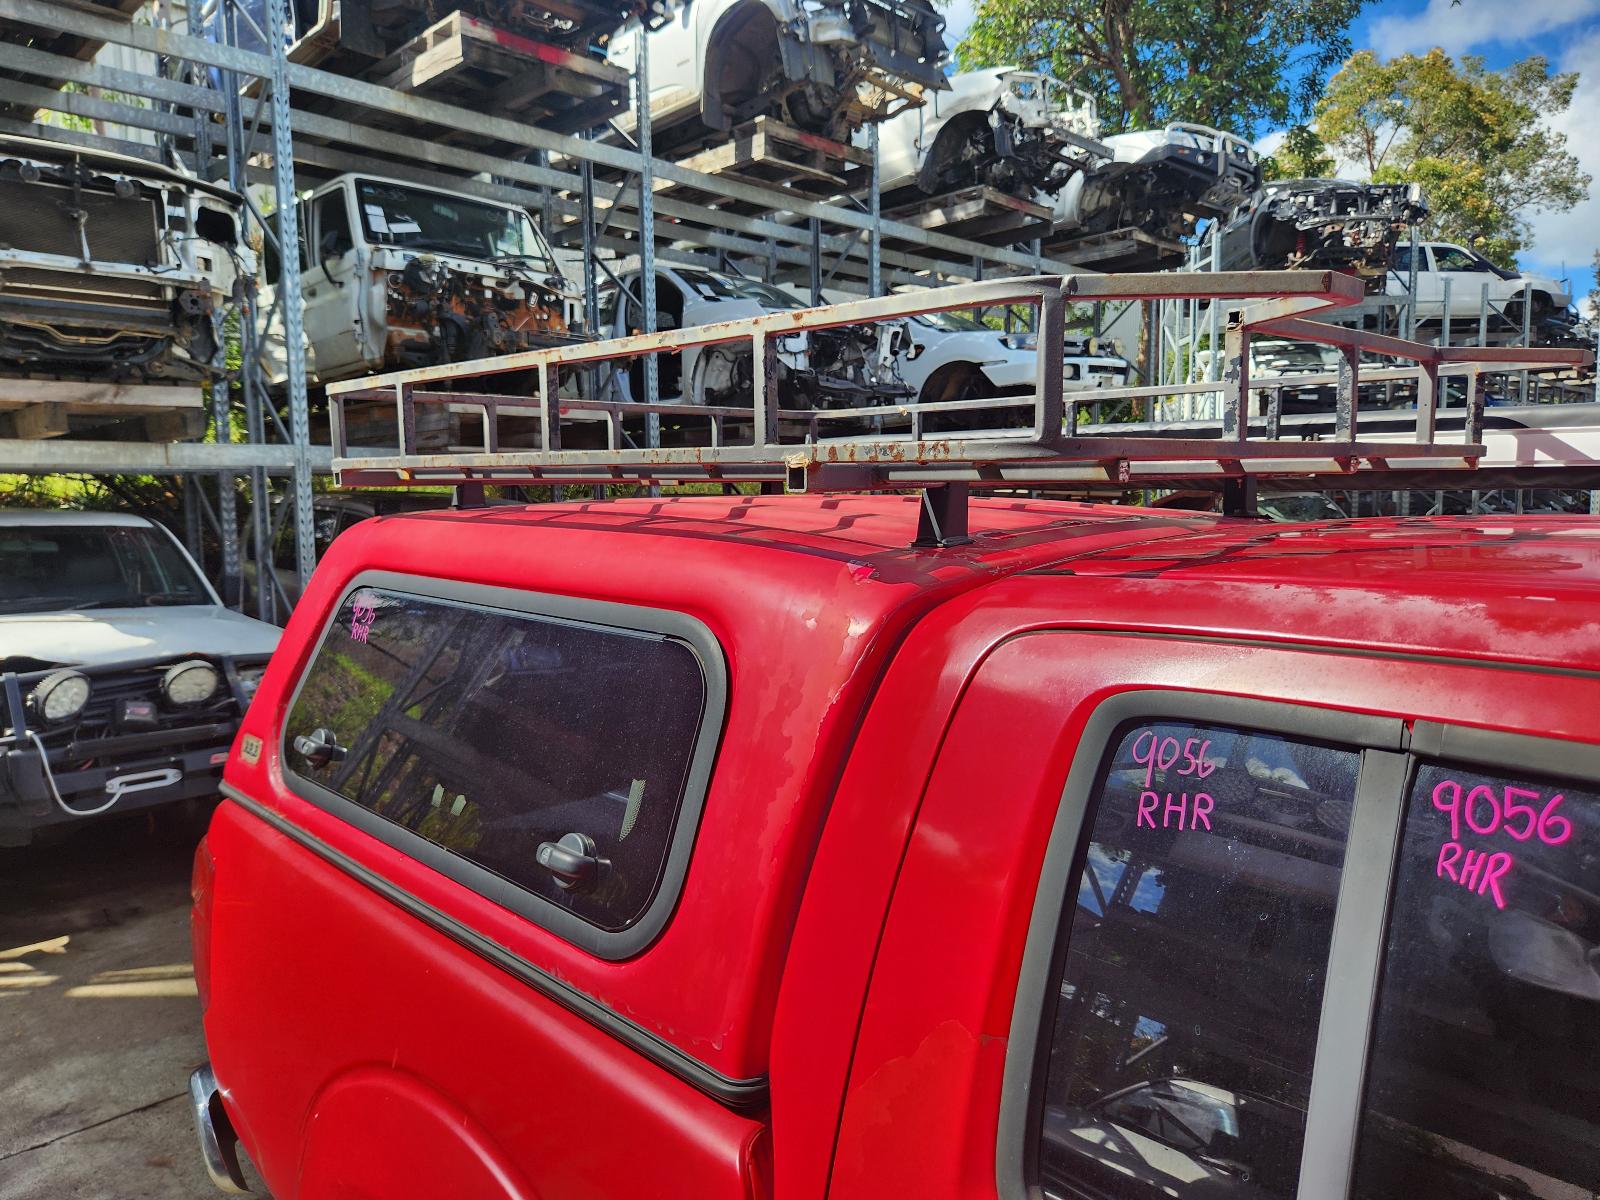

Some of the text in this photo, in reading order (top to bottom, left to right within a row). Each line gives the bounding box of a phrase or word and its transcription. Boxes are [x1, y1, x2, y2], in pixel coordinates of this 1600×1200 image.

[351, 622, 370, 644] RHR
[1132, 731, 1215, 788] 9056
[1137, 792, 1215, 832] RHR
[1432, 780, 1572, 846] 9056
[1436, 842, 1513, 909] RHR
